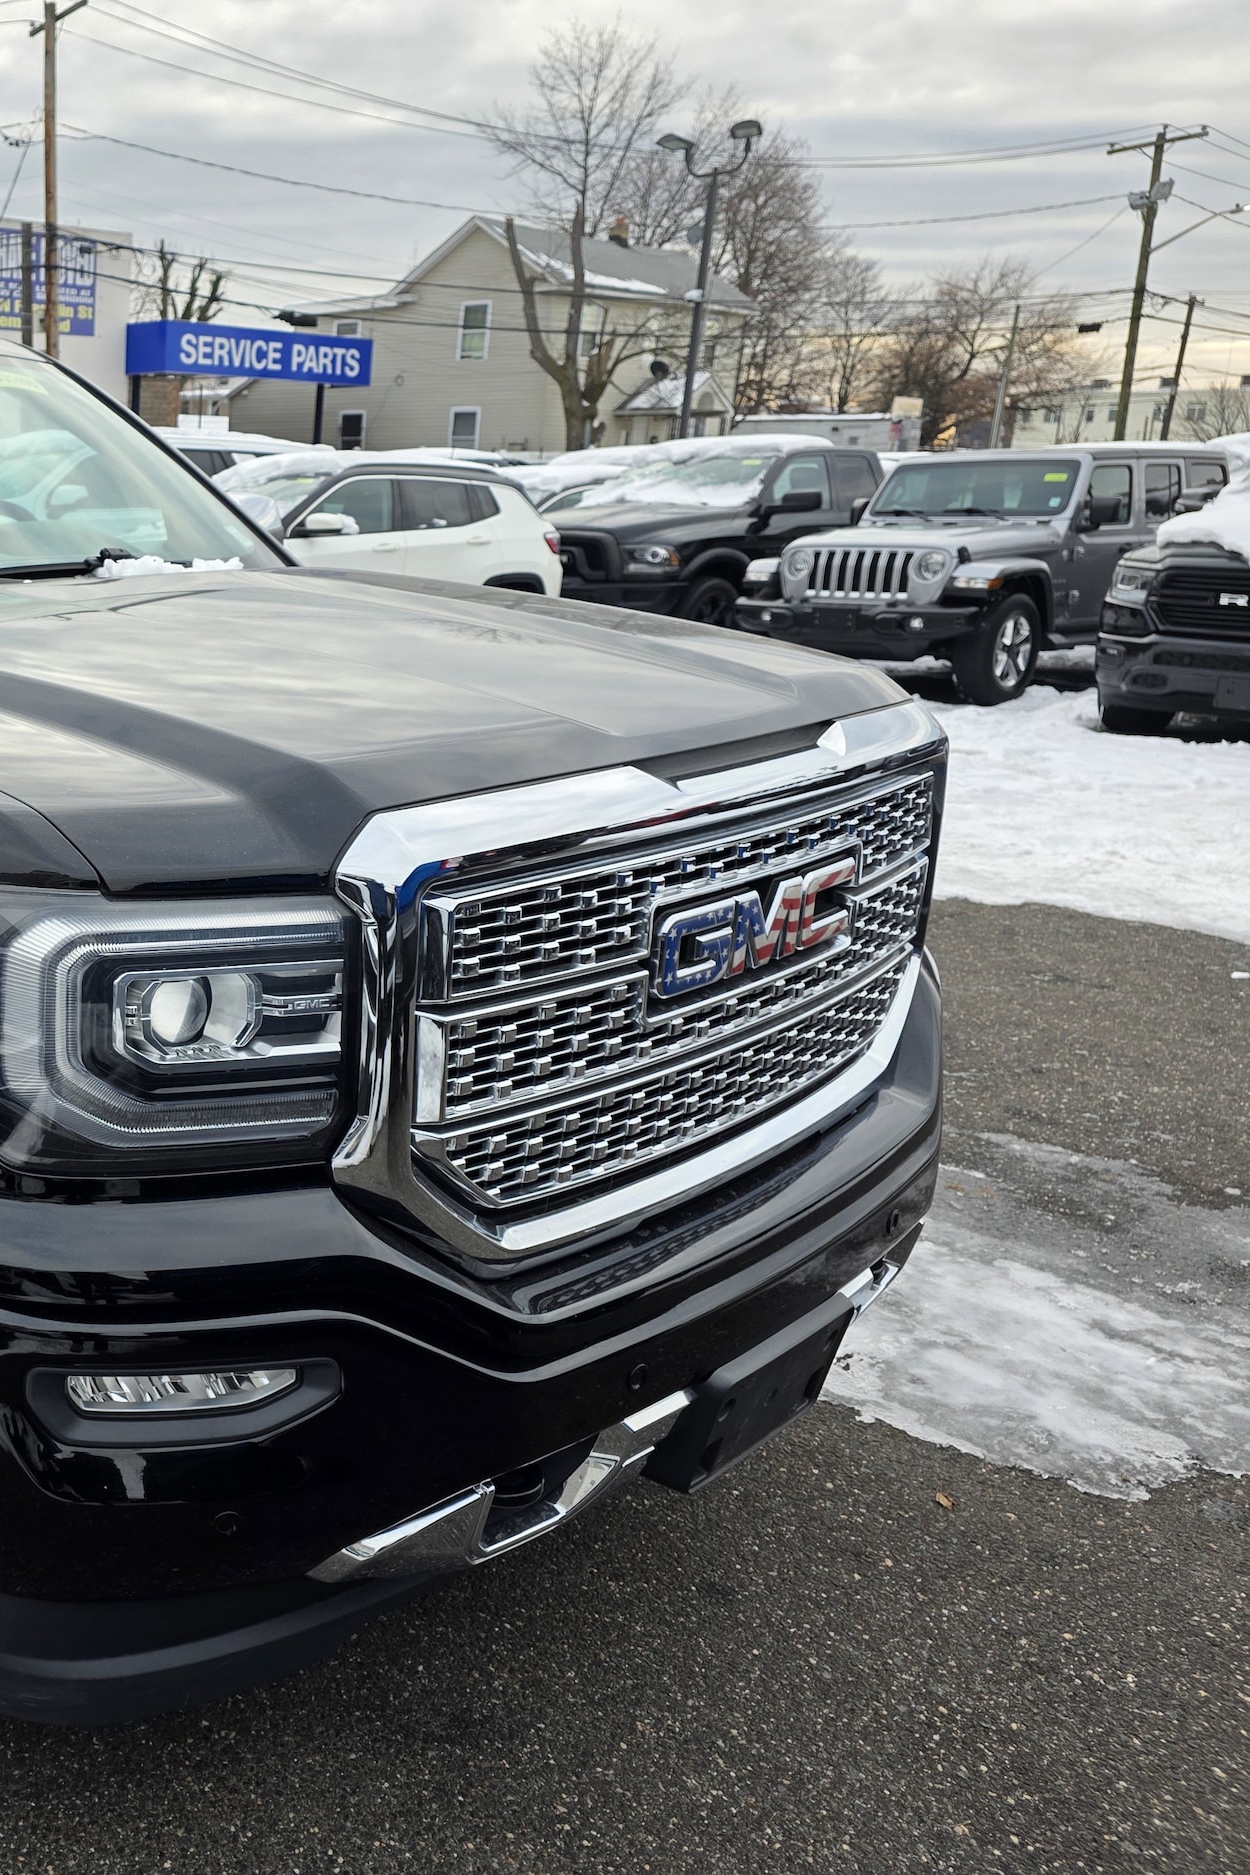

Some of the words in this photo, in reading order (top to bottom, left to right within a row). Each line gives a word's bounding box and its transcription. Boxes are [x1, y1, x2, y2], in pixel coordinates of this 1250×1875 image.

[179, 332, 282, 371] SERVICE
[291, 343, 361, 378] PARTS
[654, 856, 856, 999] GMC
[293, 998, 331, 1010] GMC
